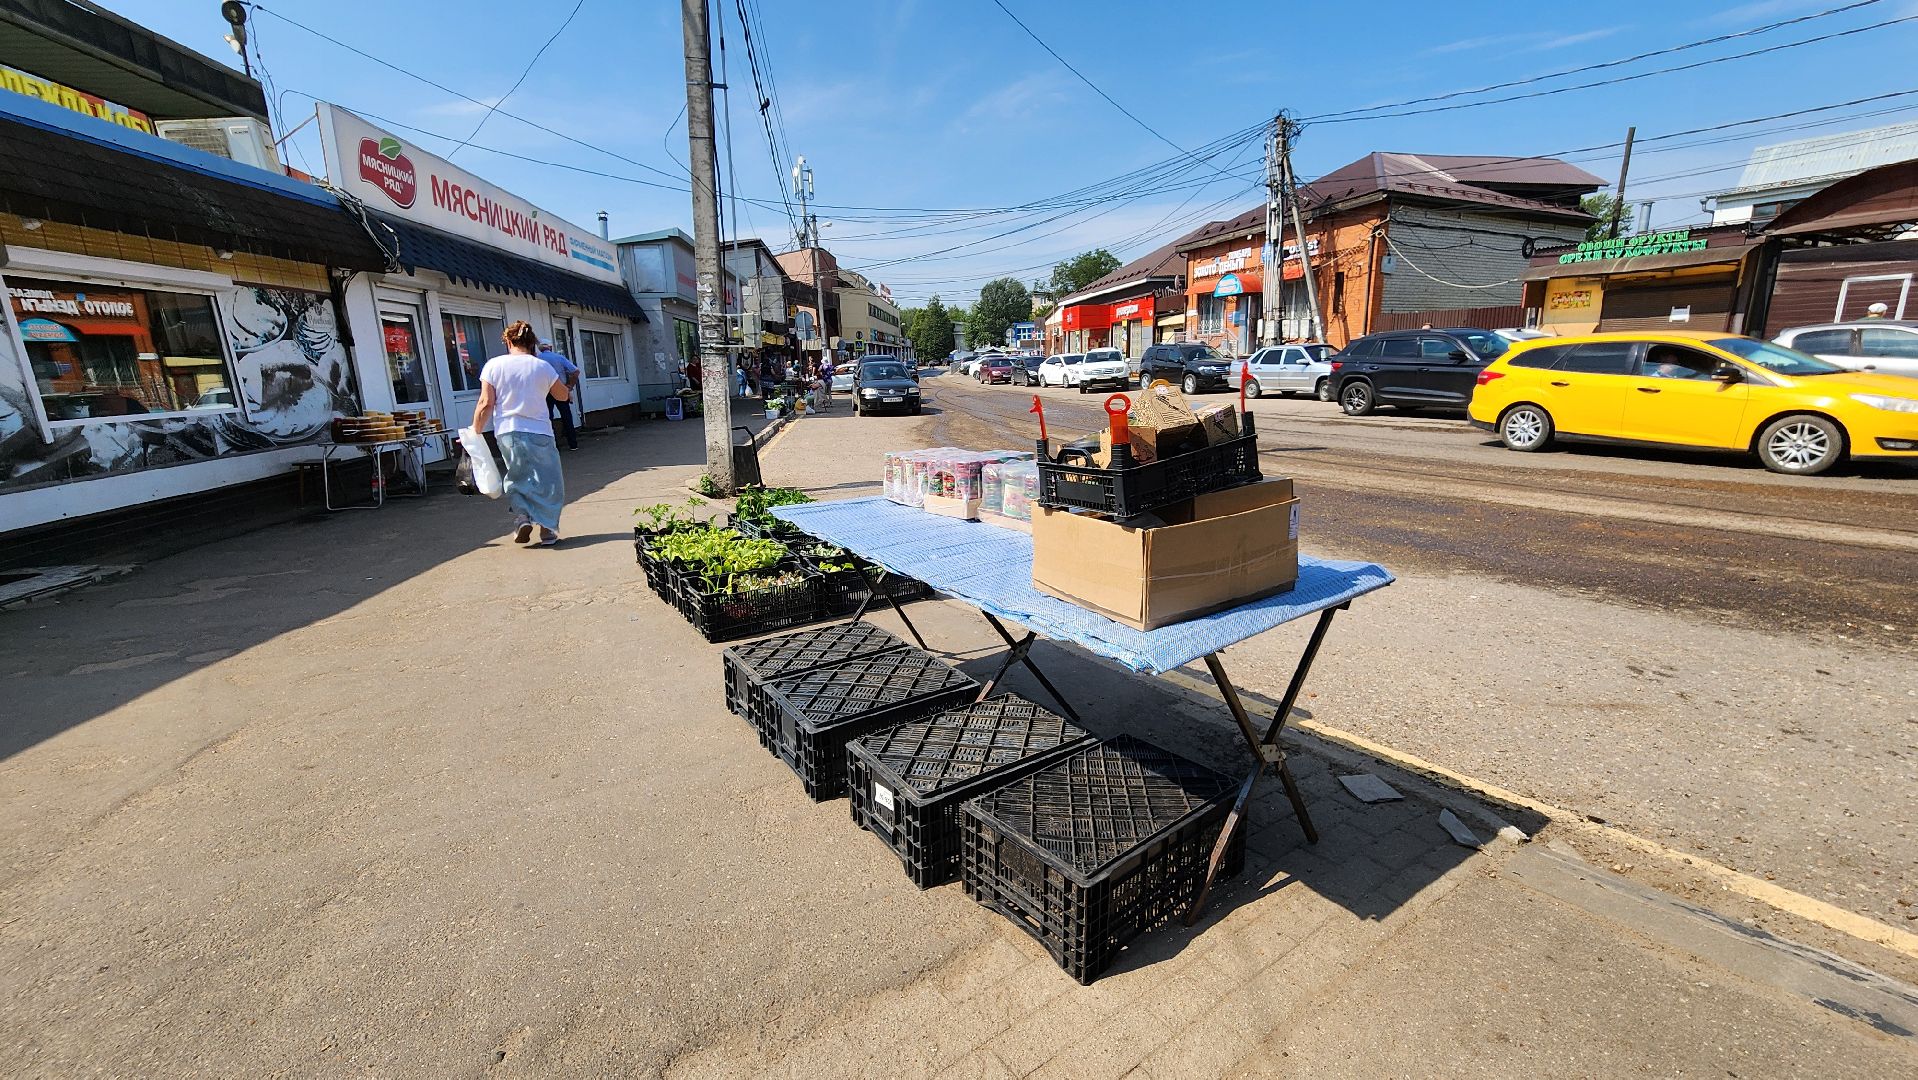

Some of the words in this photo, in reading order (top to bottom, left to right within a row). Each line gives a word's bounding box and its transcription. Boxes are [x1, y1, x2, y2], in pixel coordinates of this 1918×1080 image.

[362, 153, 415, 186] МЯСНИЦКИЙ
[383, 176, 402, 195] РЯД
[431, 174, 540, 246] МЯСНИЦКИЙ
[542, 223, 568, 258] РЯД
[1559, 250, 1603, 264] ОРЕХИ
[1605, 239, 1708, 260] СУХОФРУКТЫ
[1577, 239, 1625, 252] ОВОЩИ
[1628, 230, 1690, 248] ФРУКТЫ
